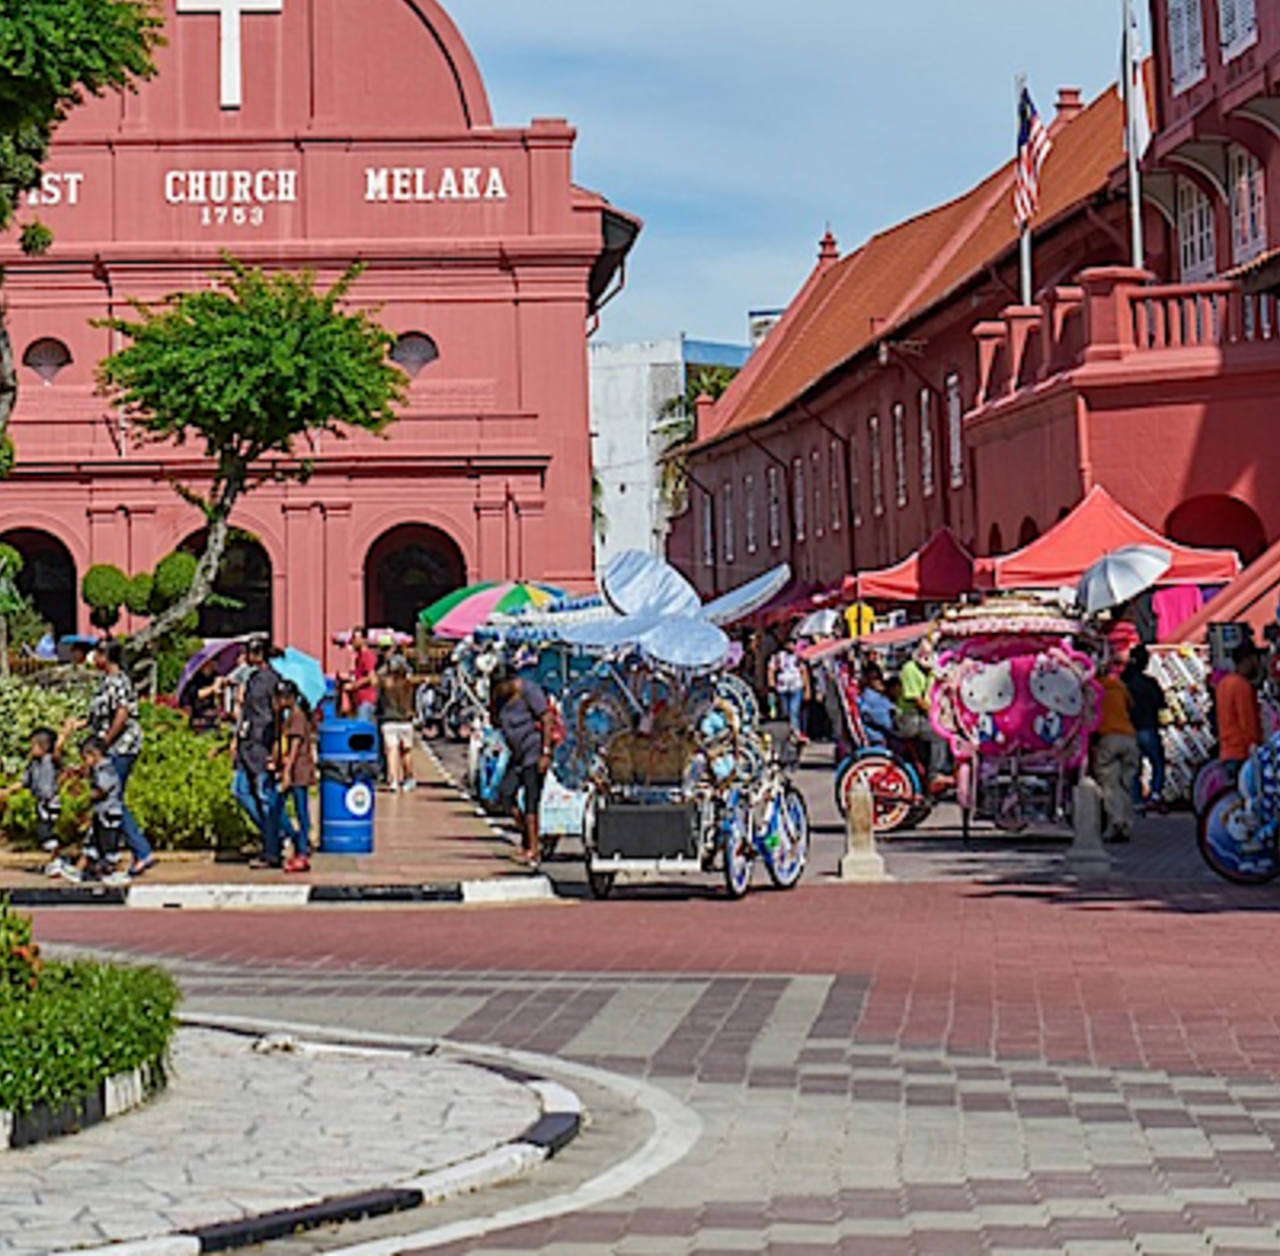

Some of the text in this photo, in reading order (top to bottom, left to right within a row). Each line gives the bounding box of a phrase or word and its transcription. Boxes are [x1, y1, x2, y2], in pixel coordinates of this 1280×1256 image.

[164, 169, 298, 203] CHURCH
[364, 166, 508, 201] MELAKA
[200, 206, 265, 226] 1753
